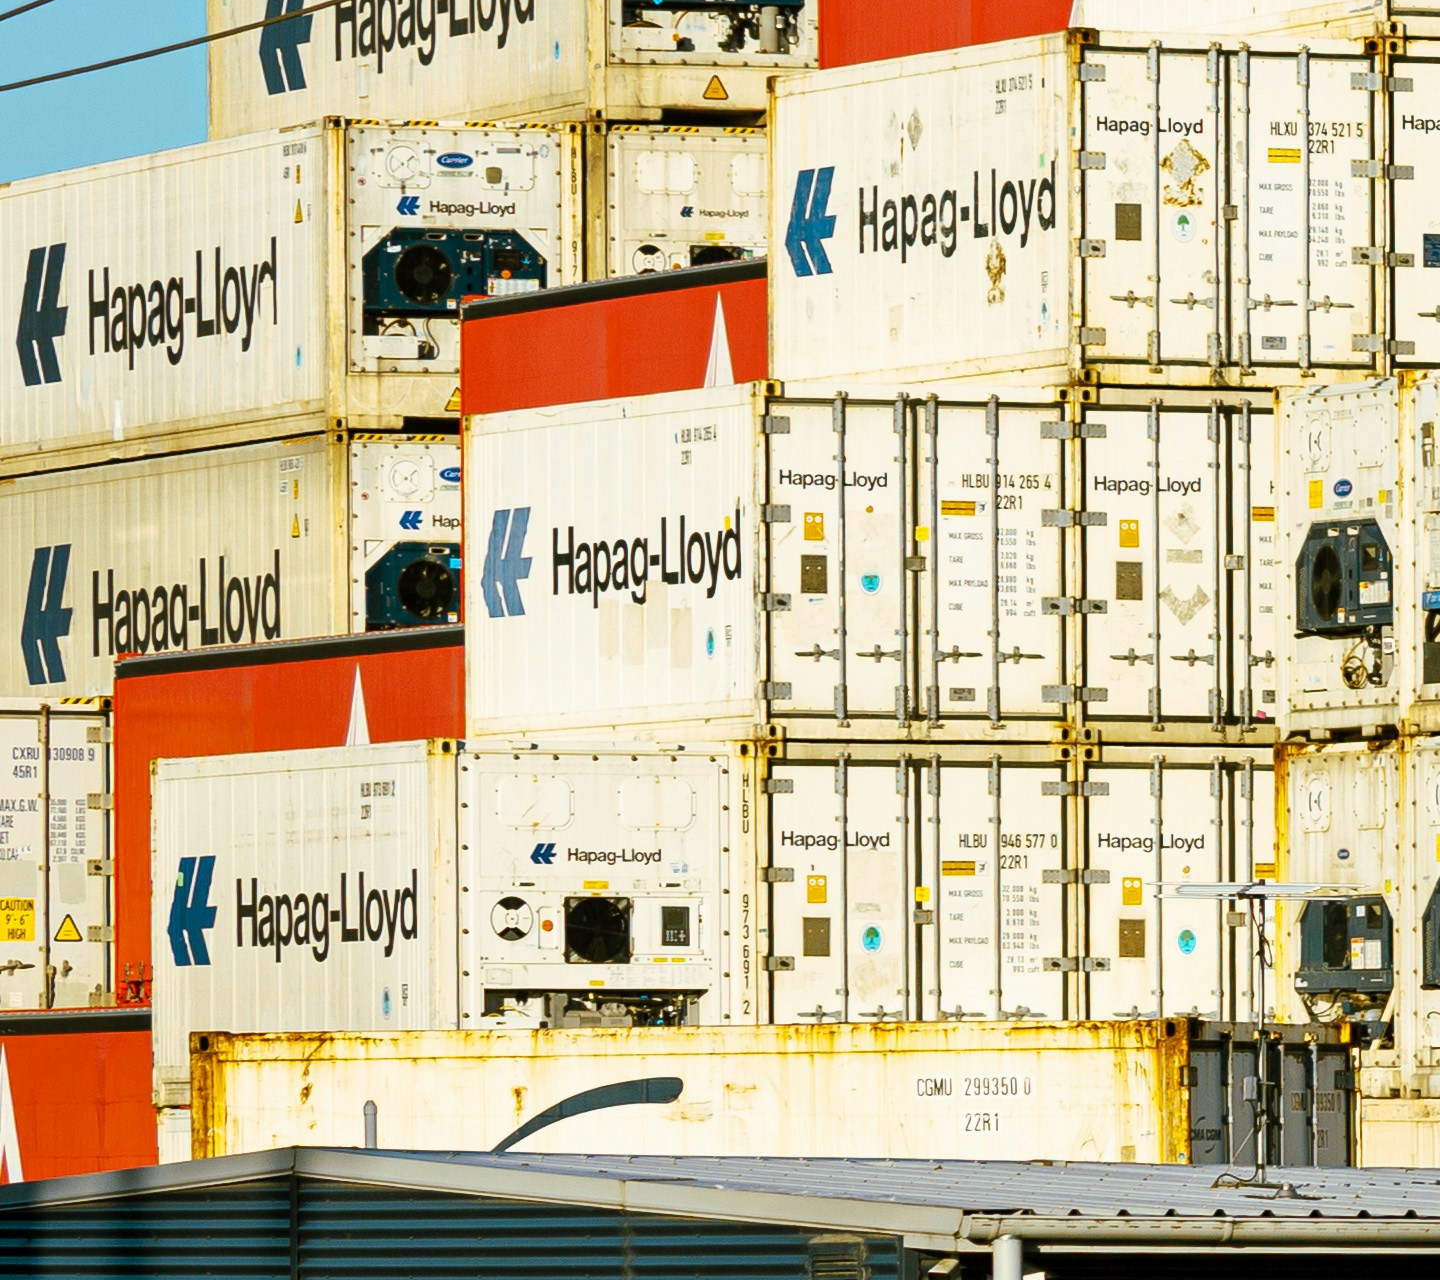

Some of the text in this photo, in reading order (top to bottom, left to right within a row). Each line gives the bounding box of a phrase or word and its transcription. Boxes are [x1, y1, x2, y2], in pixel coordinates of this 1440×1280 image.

[440, 155, 470, 166] Carrier
[429, 199, 516, 216] Hapag-Lloyd
[858, 160, 1057, 263] Hapag-Lloyd
[88, 236, 278, 370] Hapag-Lloyd
[552, 496, 742, 608] Hapag-Lloyd
[92, 548, 281, 657] Hapag-Lloyd
[12, 748, 96, 762] CXRU 130908 9
[12, 765, 38, 779] 45R1
[959, 834, 1058, 849] HLBU 946 577 0
[567, 847, 662, 865] Hapag-Lloyd
[1001, 855, 1028, 870] 22R1
[0, 899, 34, 911] CAUTION
[235, 868, 418, 963] Hapag-Lloyd
[7, 927, 27, 940] HIGH
[916, 1077, 1032, 1097] CGMU 299350 0
[965, 1113, 999, 1132] 22R1
